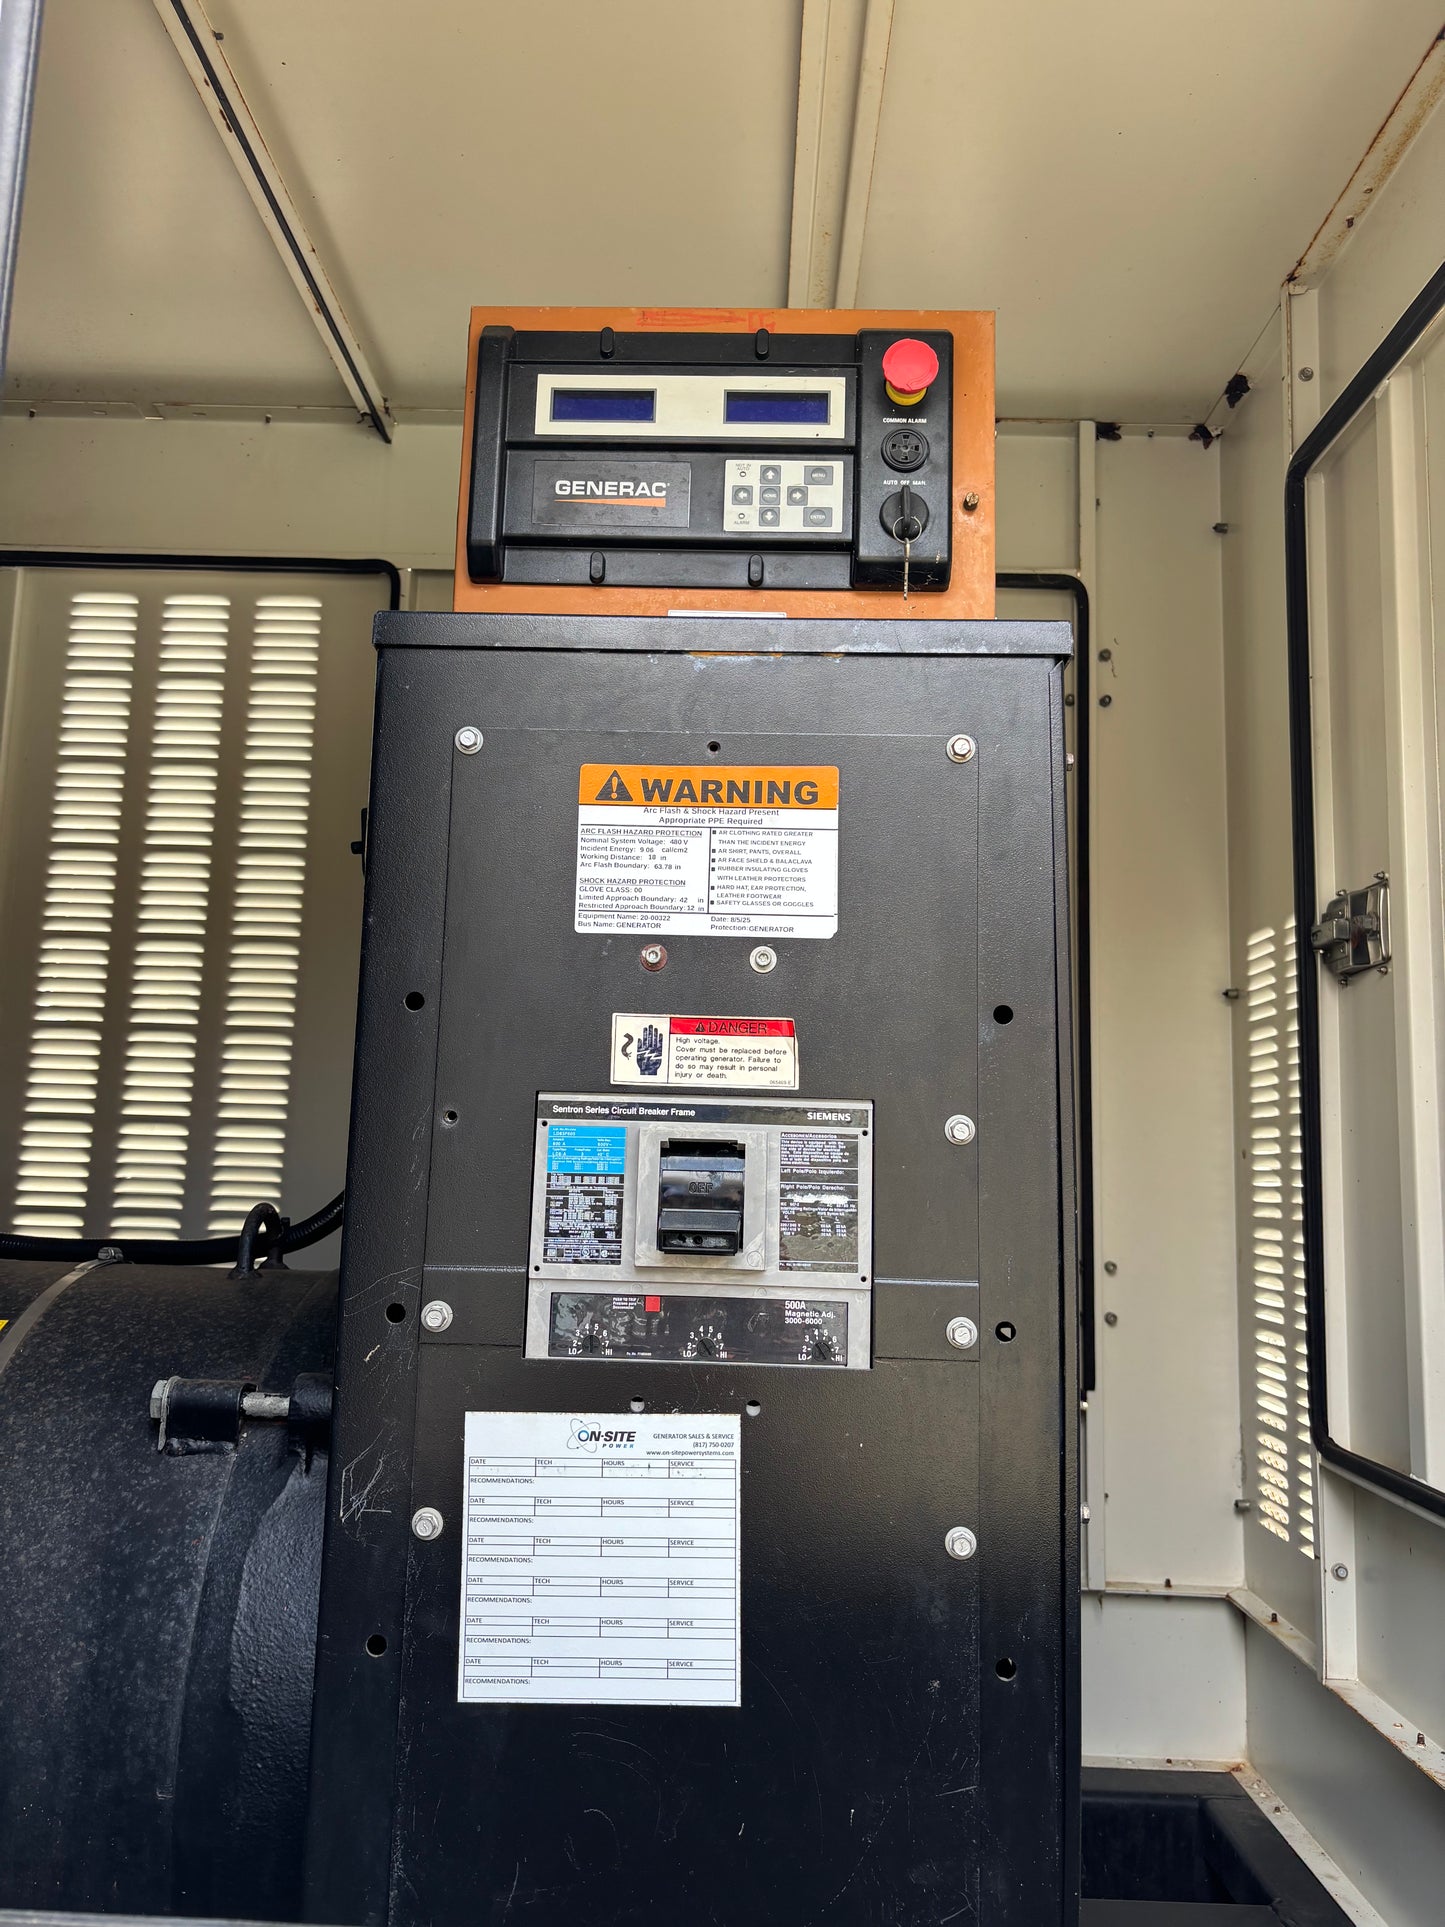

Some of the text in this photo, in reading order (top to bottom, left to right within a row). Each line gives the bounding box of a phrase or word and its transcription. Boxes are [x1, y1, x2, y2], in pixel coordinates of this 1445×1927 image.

[555, 480, 666, 496] GENERAC
[640, 778, 818, 804] WARNING
[659, 817, 706, 825] Appropriate
[727, 817, 762, 826] Required
[709, 1022, 767, 1034] DANGER
[553, 1105, 695, 1116] Sentron Series Circuit Breaker Frame
[807, 1112, 851, 1121] SIEMENS
[785, 1301, 806, 1310] 500A
[577, 1430, 636, 1442] ON-SITE
